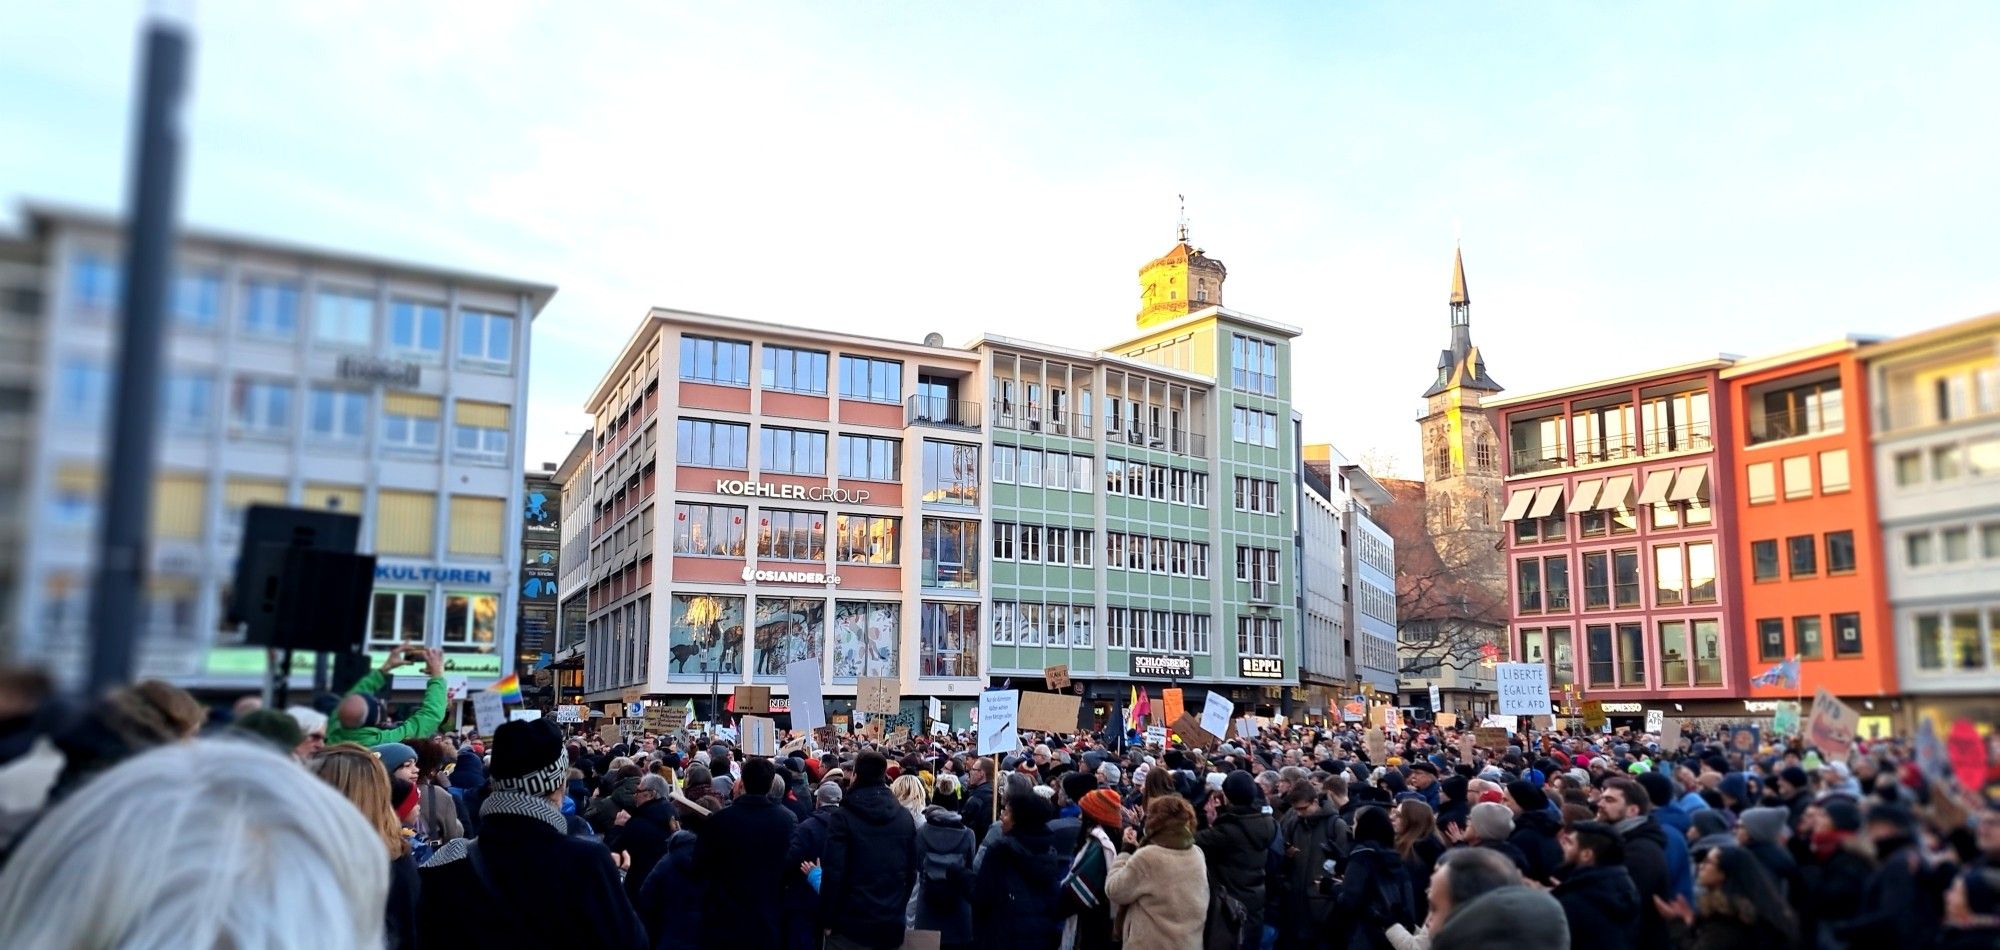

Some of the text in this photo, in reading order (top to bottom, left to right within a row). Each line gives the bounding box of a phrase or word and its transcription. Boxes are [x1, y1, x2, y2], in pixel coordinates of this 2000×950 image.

[716, 479, 870, 504] KOEHLER.GROUP
[374, 564, 492, 583] KULTUREN
[755, 570, 841, 585] OSIANDER.de
[1135, 656, 1190, 670] SCHLOSSBERG
[1504, 684, 1544, 696] ÉGALITÉ
[1506, 700, 1545, 709] FCK AFD
[1601, 703, 1642, 713] ESPRESSO
